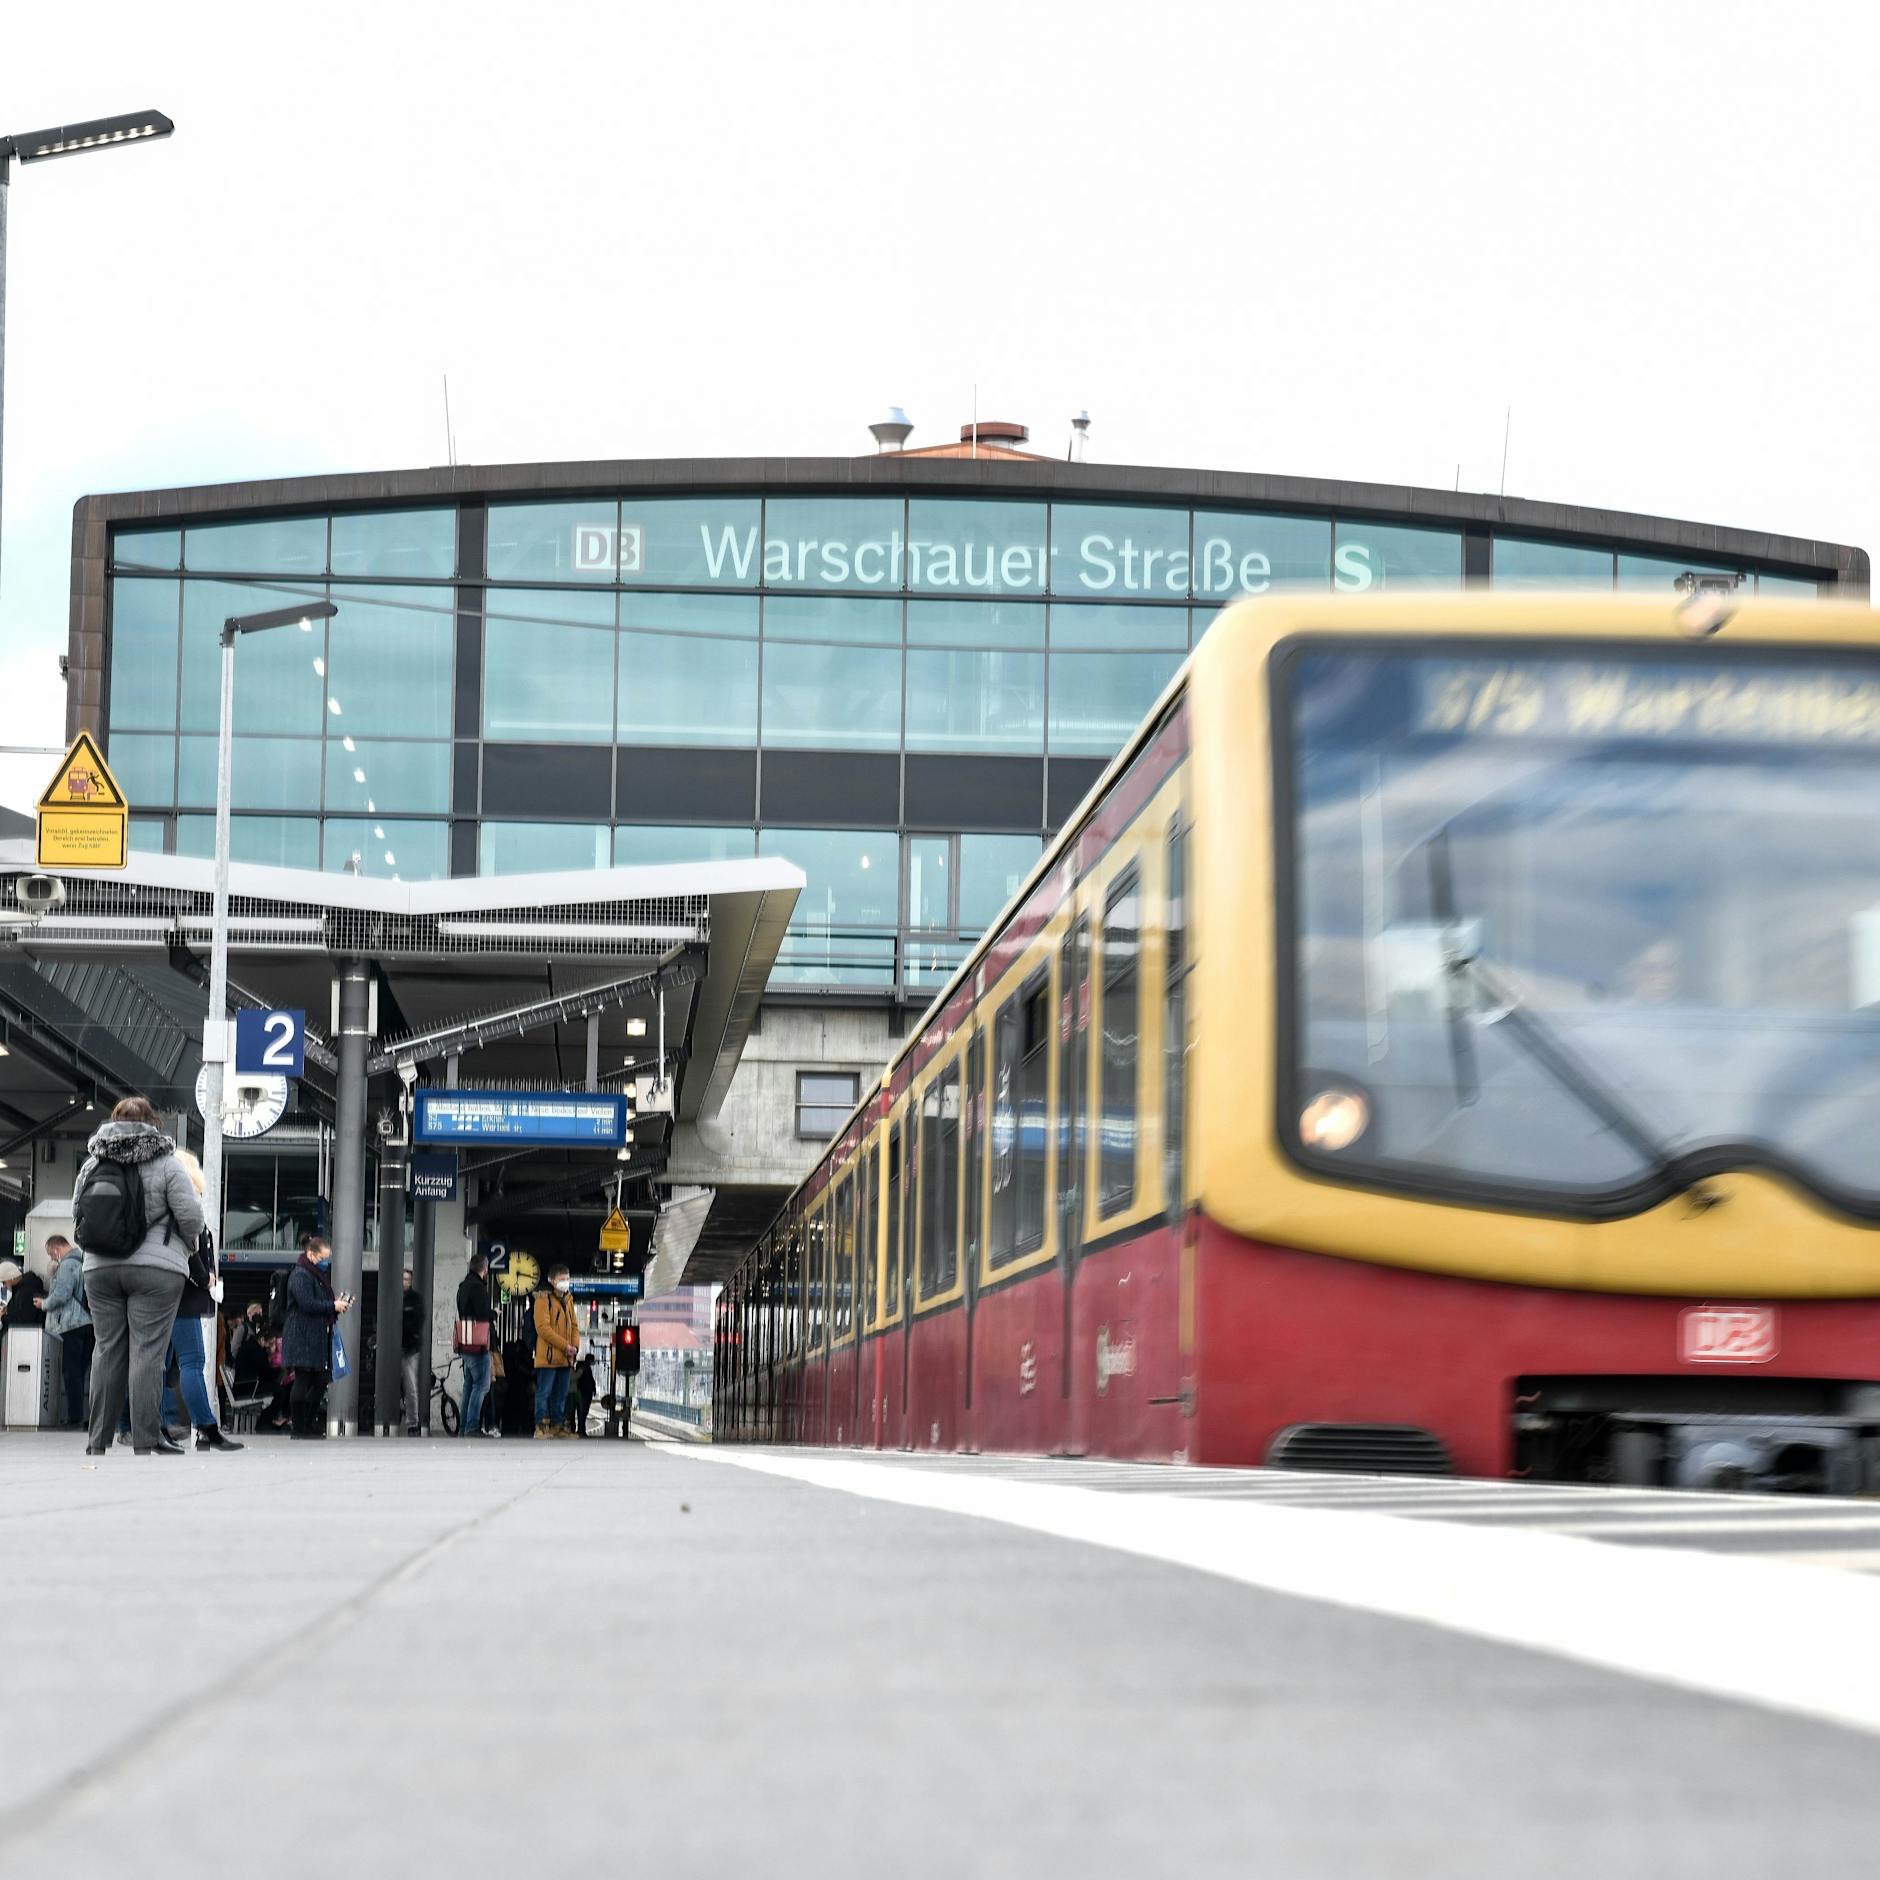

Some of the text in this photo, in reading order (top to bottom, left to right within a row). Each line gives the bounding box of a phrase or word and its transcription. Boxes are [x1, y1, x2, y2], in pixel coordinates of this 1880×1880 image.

[577, 524, 1373, 594] DB Warschauer Straße S
[263, 1011, 295, 1066] 2
[414, 1174, 453, 1188] Kurzzug
[415, 1186, 447, 1198] Anfang
[490, 1244, 506, 1269] 2
